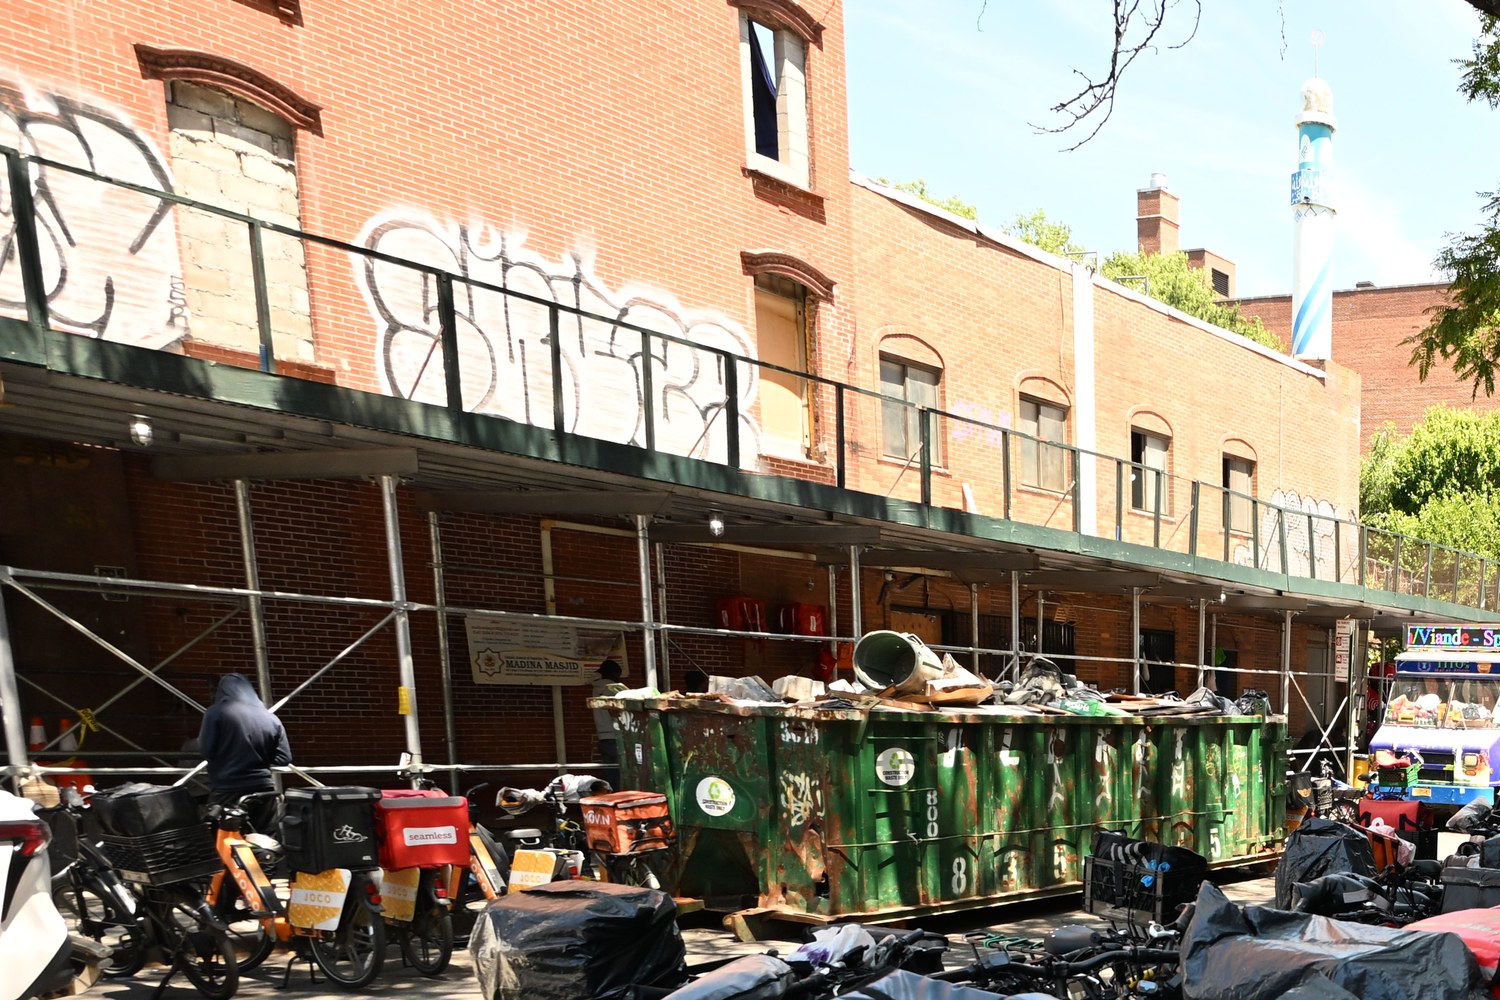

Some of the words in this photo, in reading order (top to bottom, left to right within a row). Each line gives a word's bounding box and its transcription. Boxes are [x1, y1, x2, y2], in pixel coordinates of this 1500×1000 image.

[505, 660, 542, 669] MADINA
[545, 661, 579, 670] MASJID
[409, 831, 452, 842] seamless
[303, 892, 332, 904] JOCO
